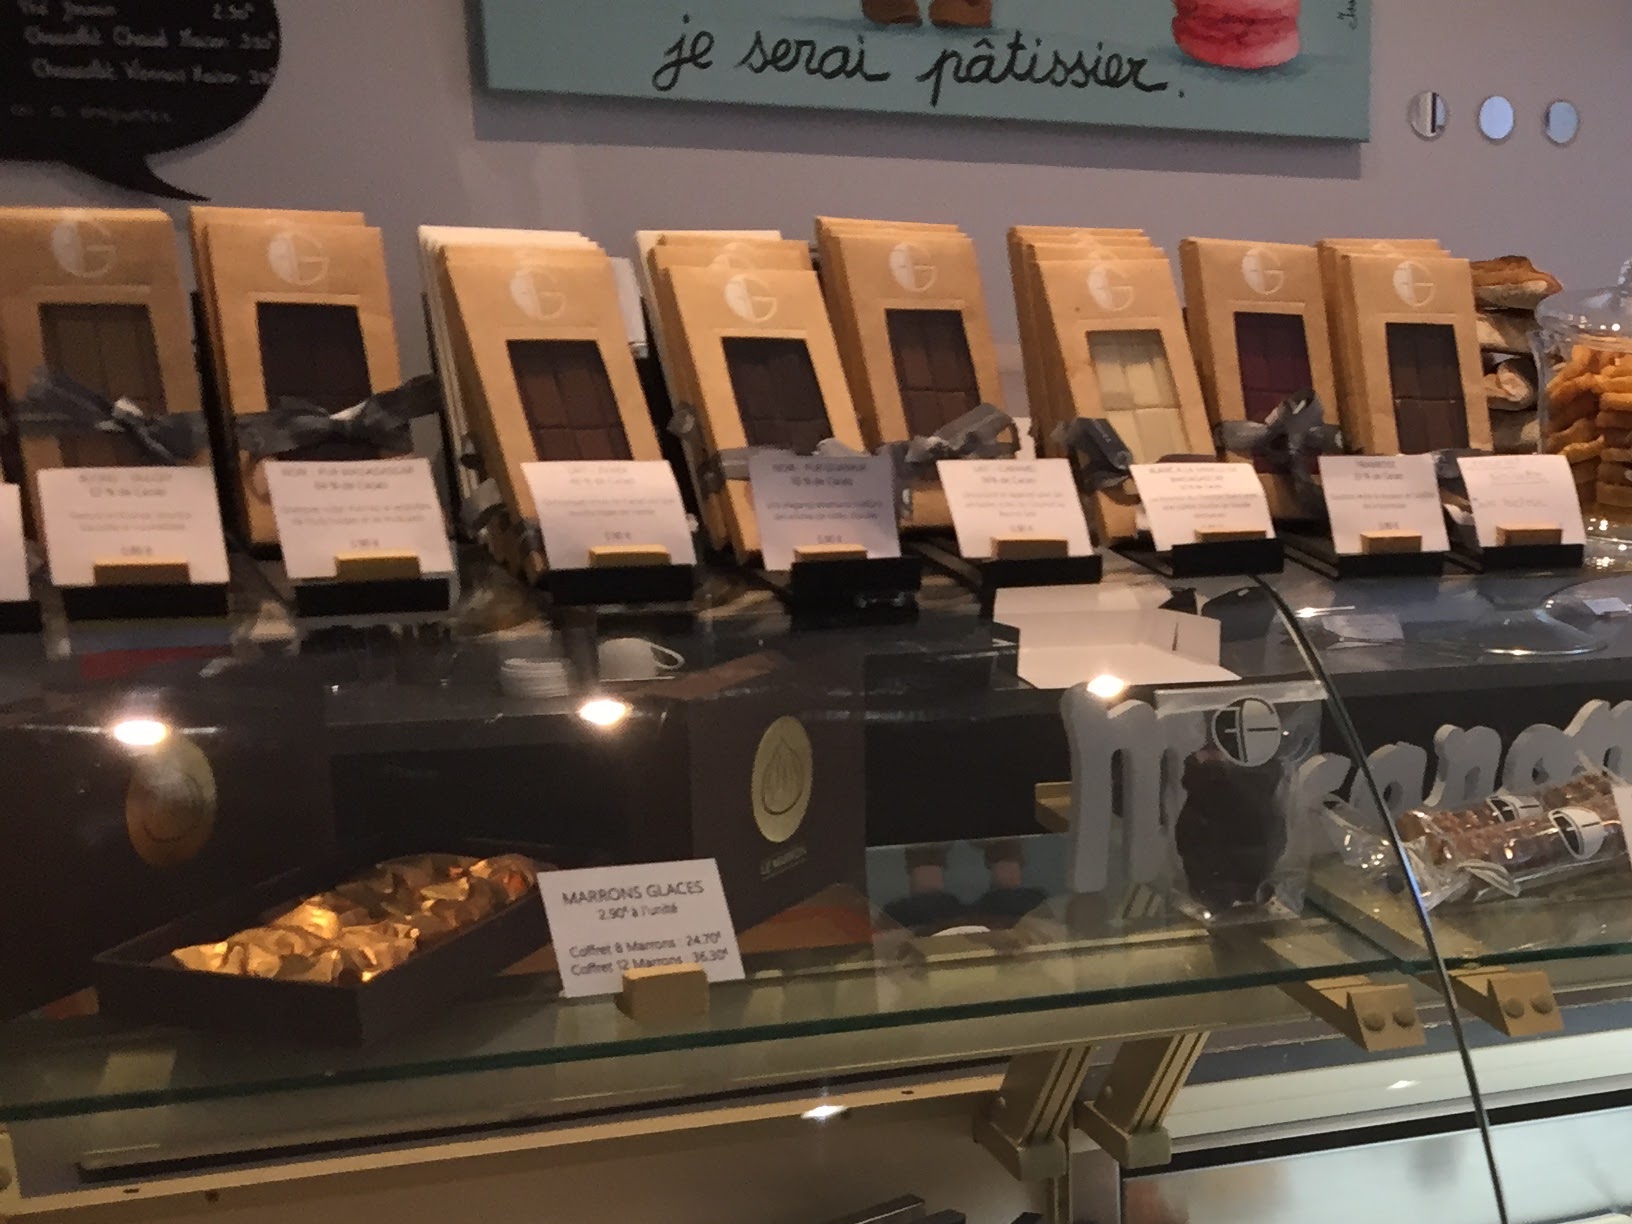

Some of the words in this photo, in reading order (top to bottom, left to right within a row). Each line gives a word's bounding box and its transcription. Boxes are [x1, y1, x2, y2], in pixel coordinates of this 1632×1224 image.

[651, 13, 717, 93] je
[737, 33, 890, 83] serai
[562, 885, 642, 905] MARRONS
[646, 880, 705, 897] GLACES
[568, 944, 612, 959] Coffret
[626, 938, 677, 952] Marrons
[570, 961, 614, 977] Coffret
